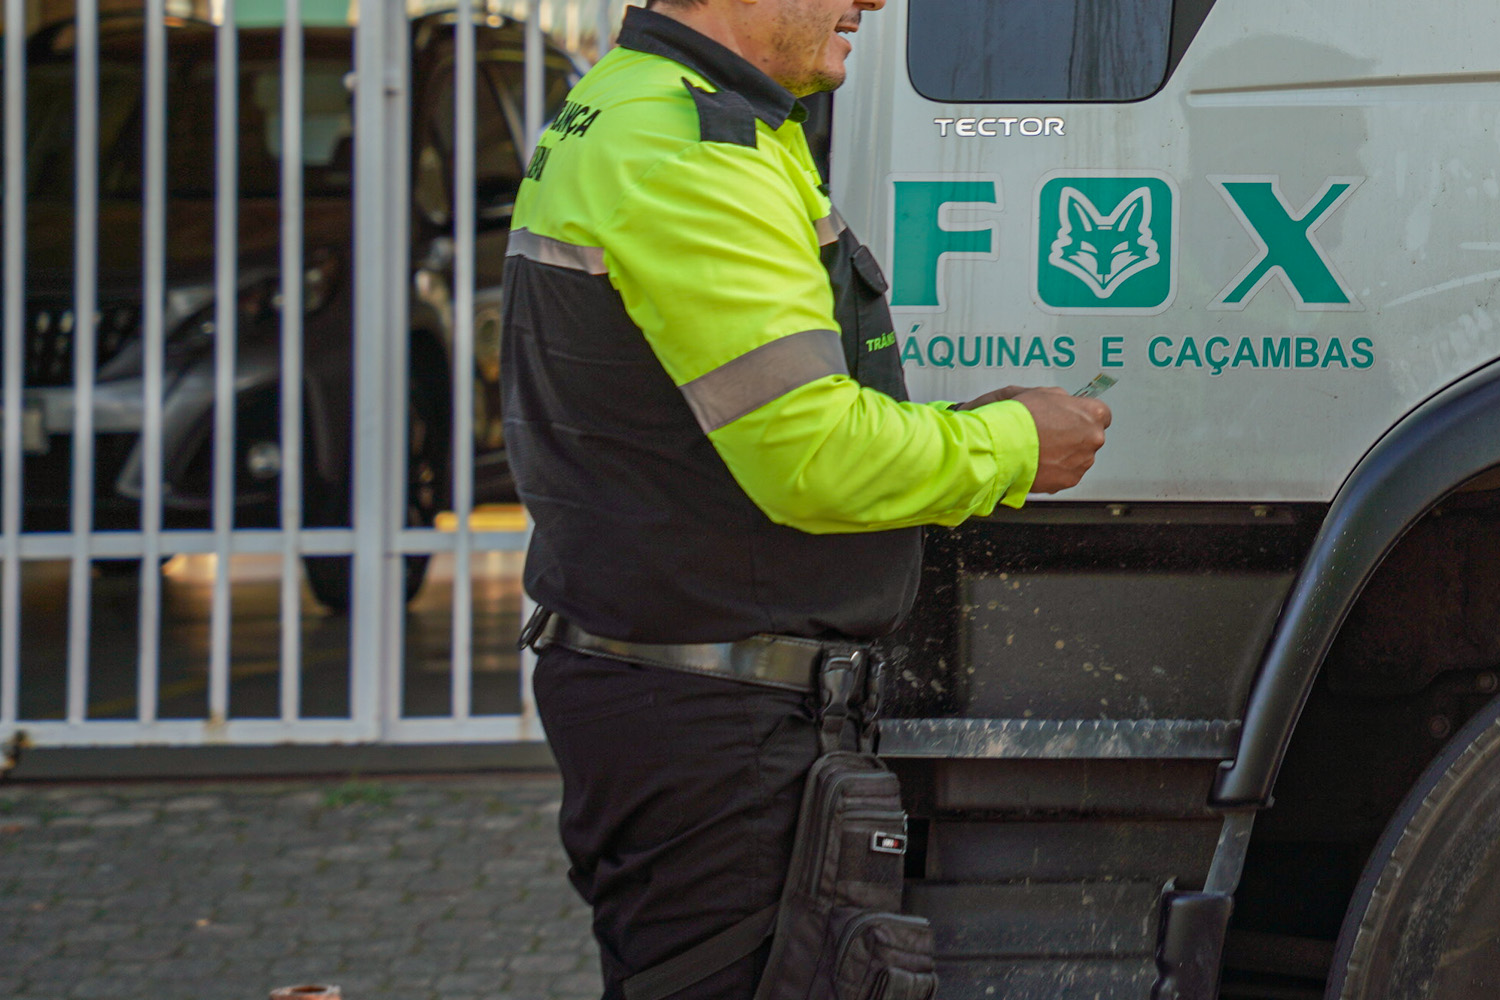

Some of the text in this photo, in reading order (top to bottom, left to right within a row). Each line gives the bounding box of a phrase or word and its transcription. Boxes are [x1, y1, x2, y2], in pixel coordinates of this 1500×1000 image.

[933, 117, 1066, 137] TECTOR
[900, 324, 1375, 376] ÁQUINAS E CAÇAMBAS
